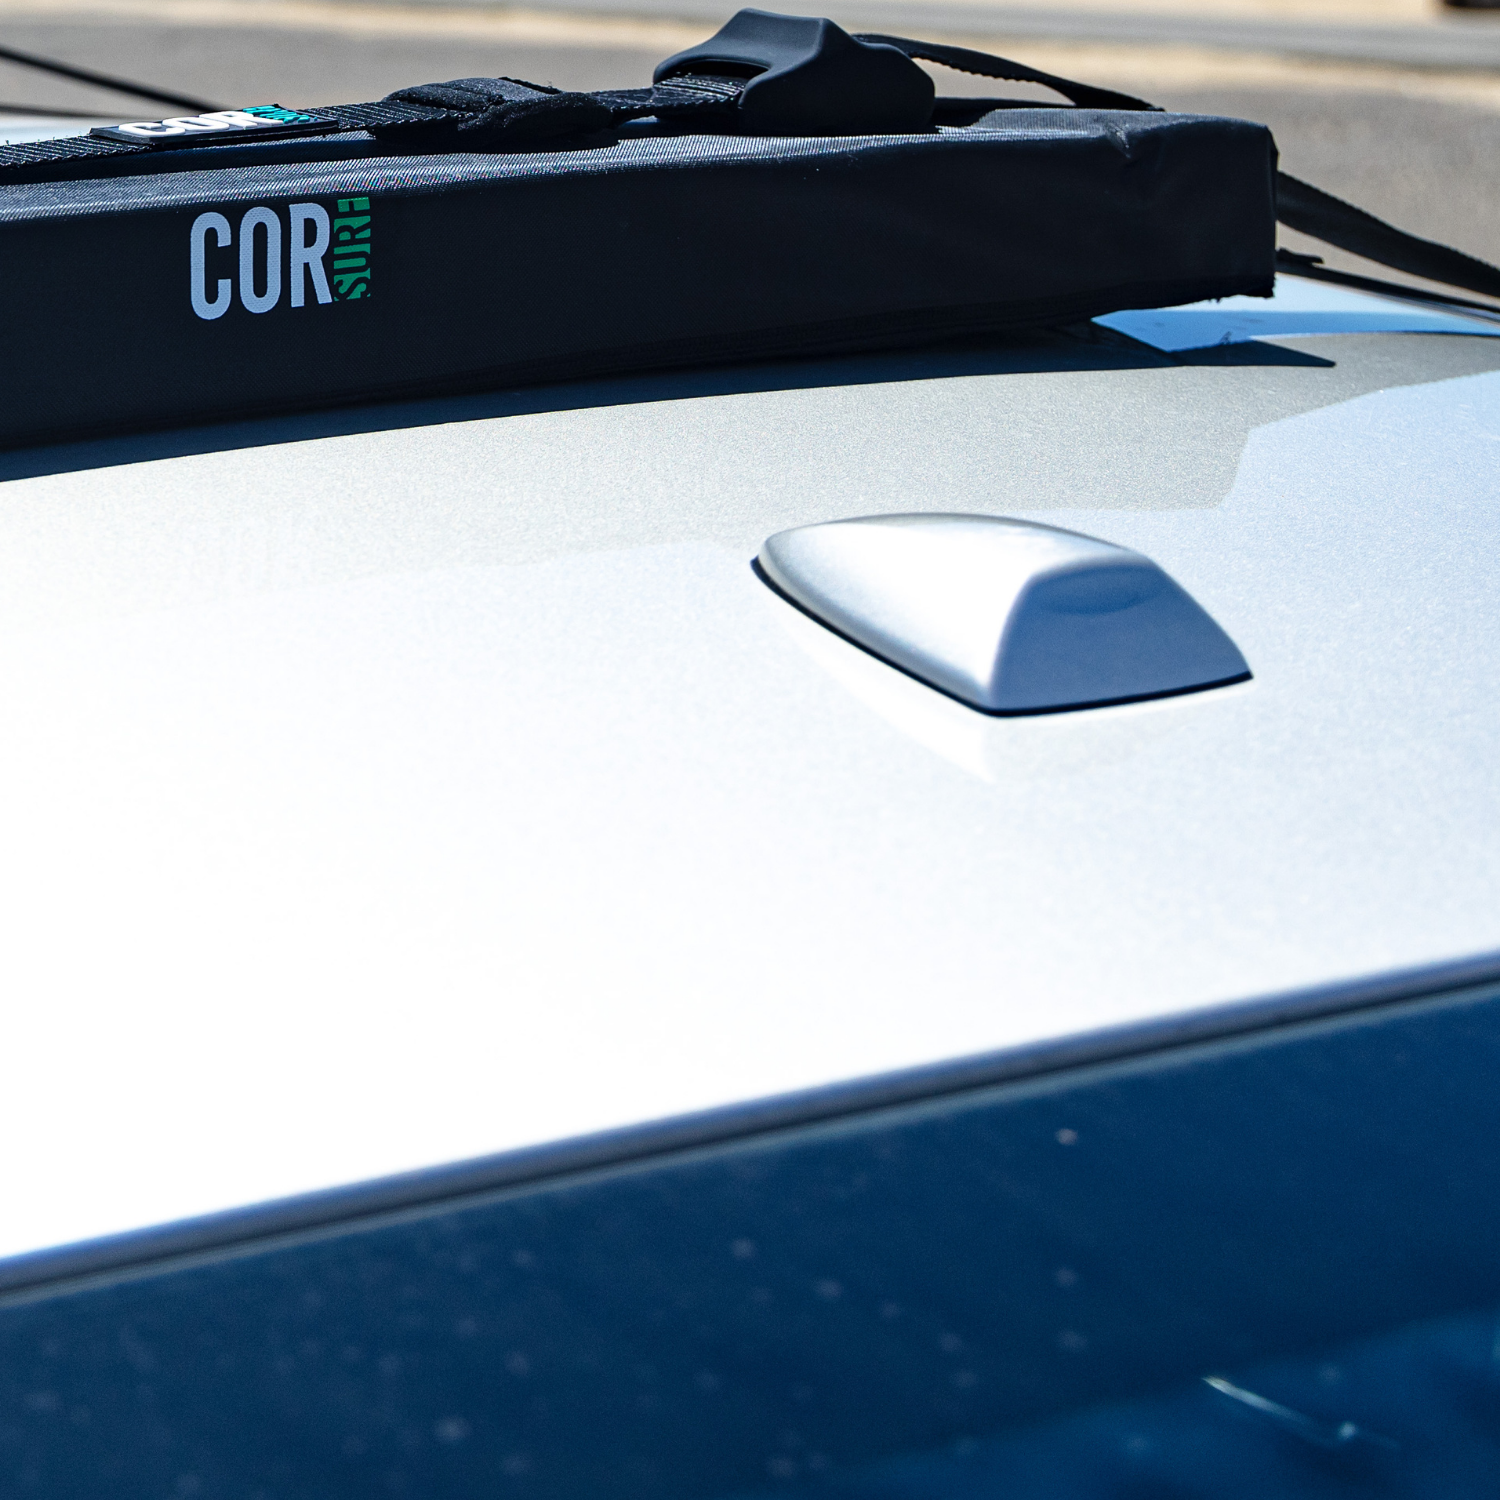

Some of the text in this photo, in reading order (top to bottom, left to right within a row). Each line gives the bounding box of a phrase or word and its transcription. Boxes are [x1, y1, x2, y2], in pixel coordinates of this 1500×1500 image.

[118, 110, 284, 137] COR
[190, 202, 333, 320] COR
[333, 197, 371, 301] SURF
